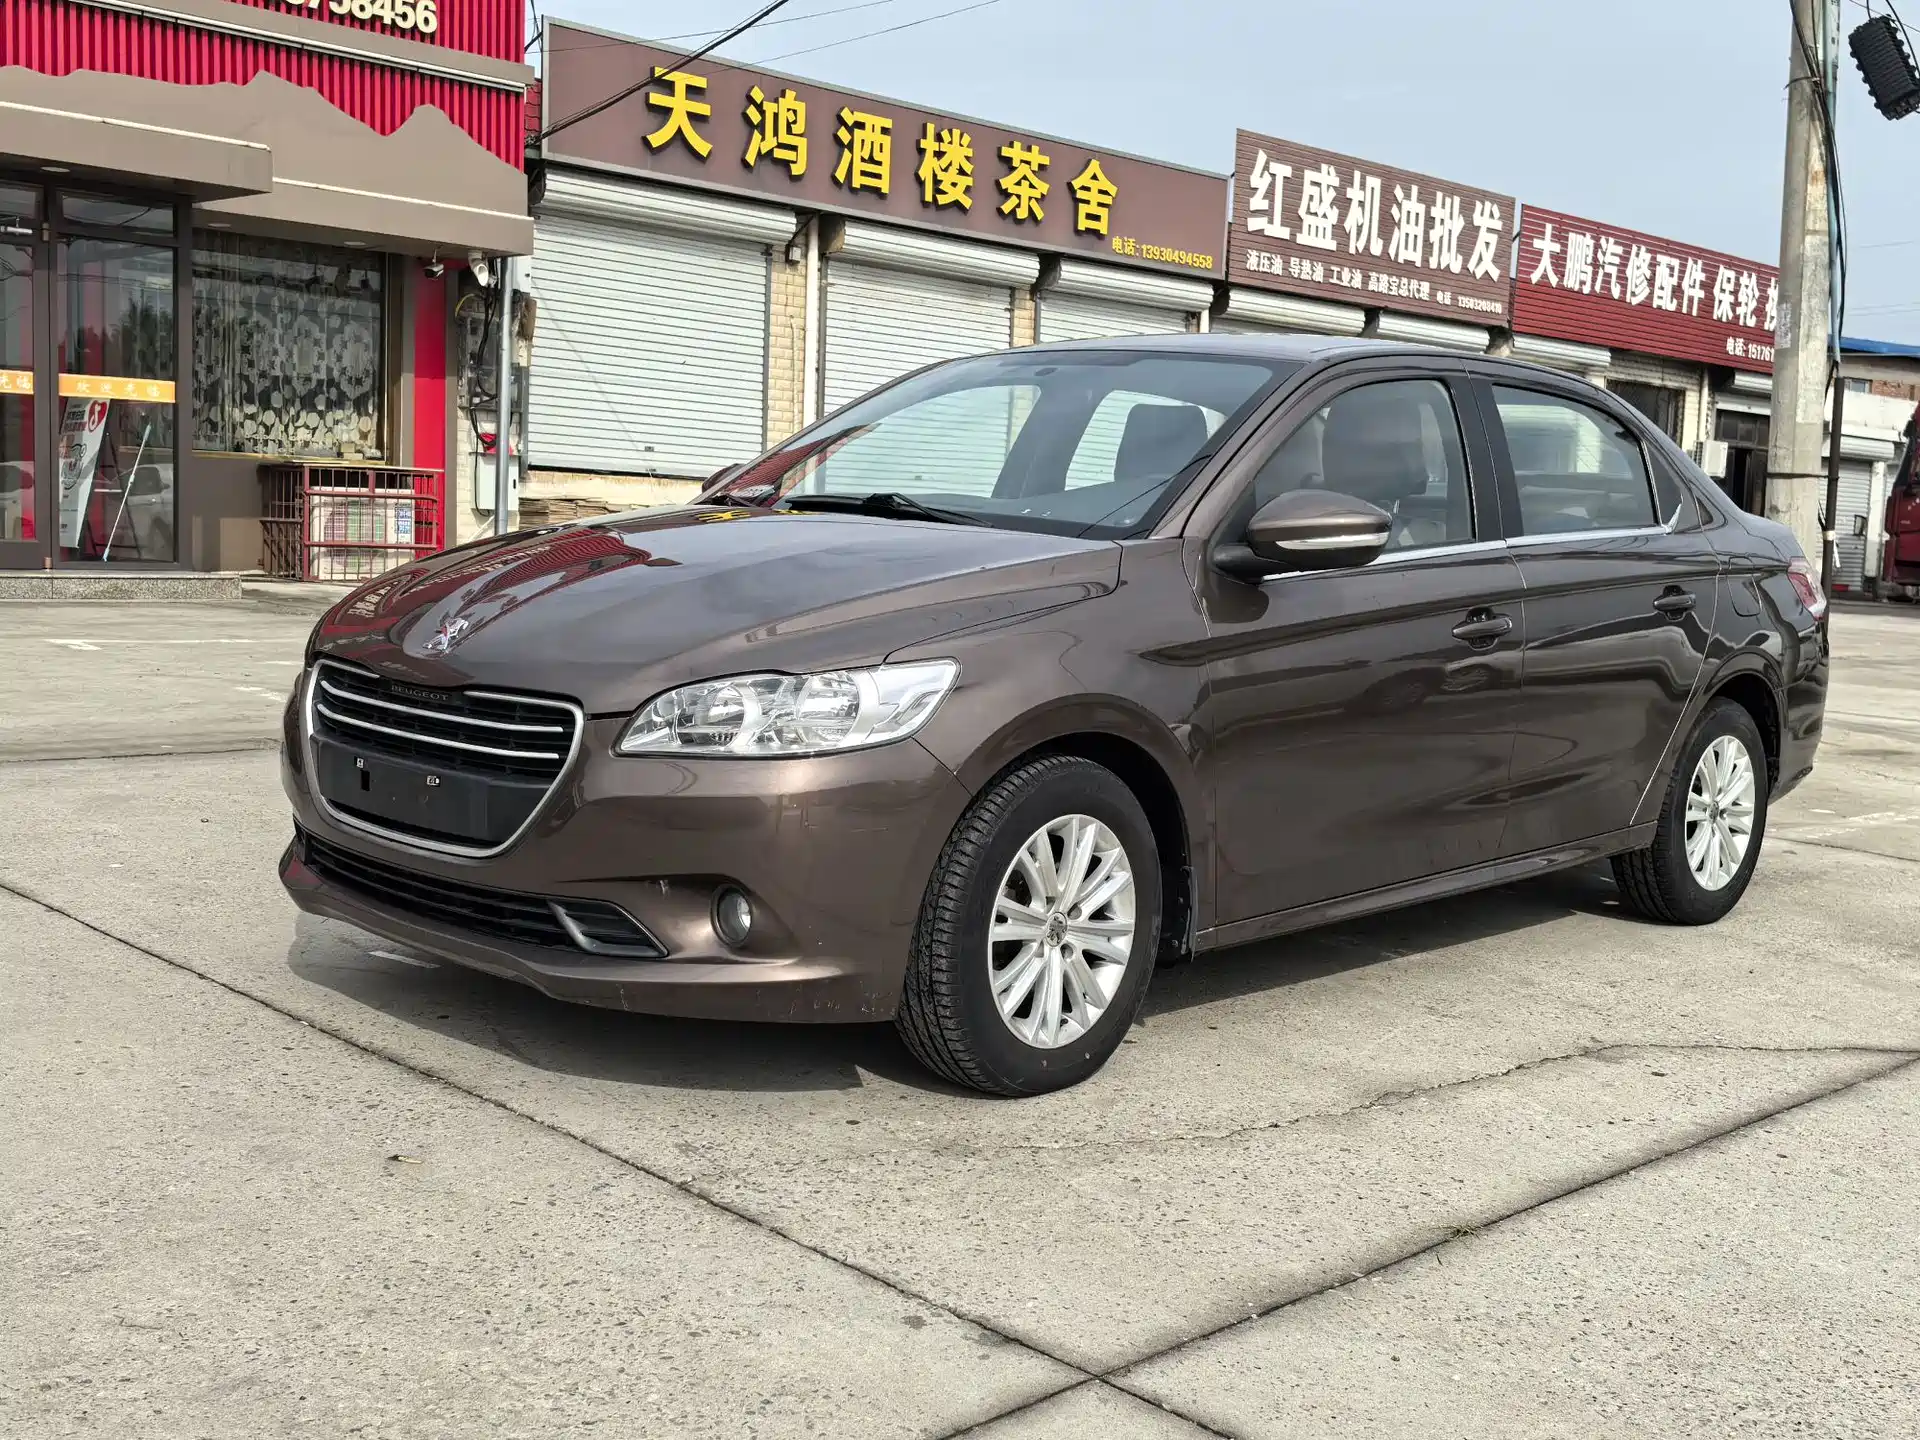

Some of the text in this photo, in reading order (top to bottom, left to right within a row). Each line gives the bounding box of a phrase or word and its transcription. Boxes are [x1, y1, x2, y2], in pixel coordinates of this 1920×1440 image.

[645, 66, 1118, 235] 天鸿酒楼茶舍
[1246, 149, 1502, 282] 红盛机油批发
[1246, 249, 1283, 276] 液压油
[1289, 256, 1324, 283] 导热油
[1329, 266, 1363, 290] 工业油
[1436, 290, 1452, 306] 电话
[1530, 223, 1706, 318] 大鹏汽修配件
[1712, 264, 1760, 328] 保轮
[391, 684, 449, 701] PEUGEOT
